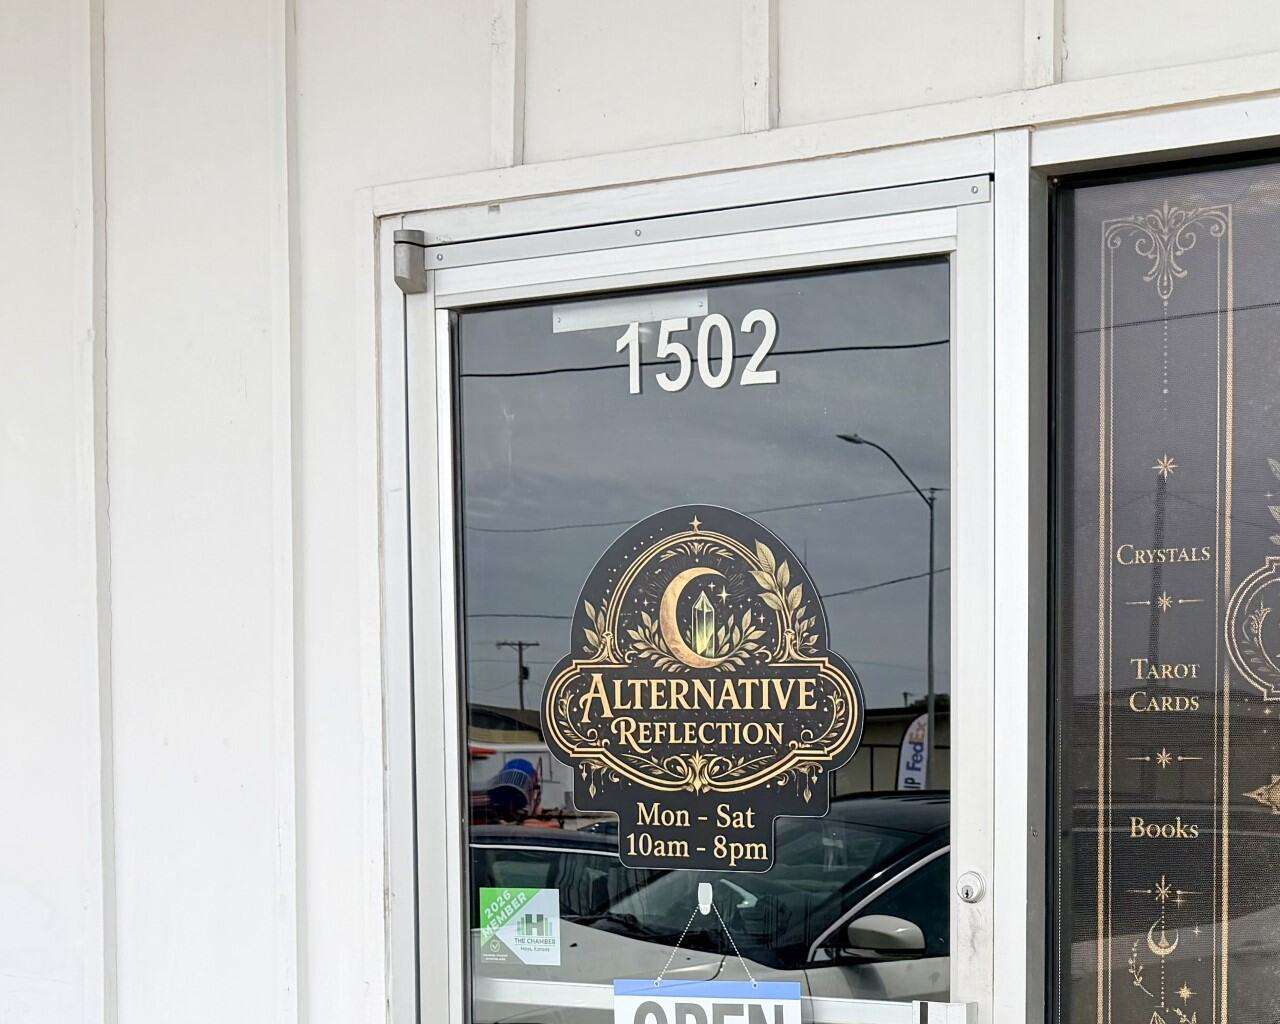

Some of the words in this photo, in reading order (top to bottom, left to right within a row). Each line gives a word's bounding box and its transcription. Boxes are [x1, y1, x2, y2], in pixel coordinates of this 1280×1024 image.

[616, 309, 778, 394] 1502
[1116, 544, 1211, 566] CRYSTALS
[1130, 658, 1200, 680] TAROT
[579, 673, 817, 723] ALTERNATIVE
[1129, 691, 1200, 712] CARDS
[611, 716, 784, 753] REFLECTION
[636, 802, 691, 827] Mon
[716, 804, 756, 829] Sat
[1130, 816, 1200, 840] Books
[626, 832, 690, 858] 10am
[713, 835, 769, 867] 8pm
[482, 892, 527, 938] MEMBER
[485, 889, 512, 918] 2026
[527, 937, 556, 945] CHAMBER
